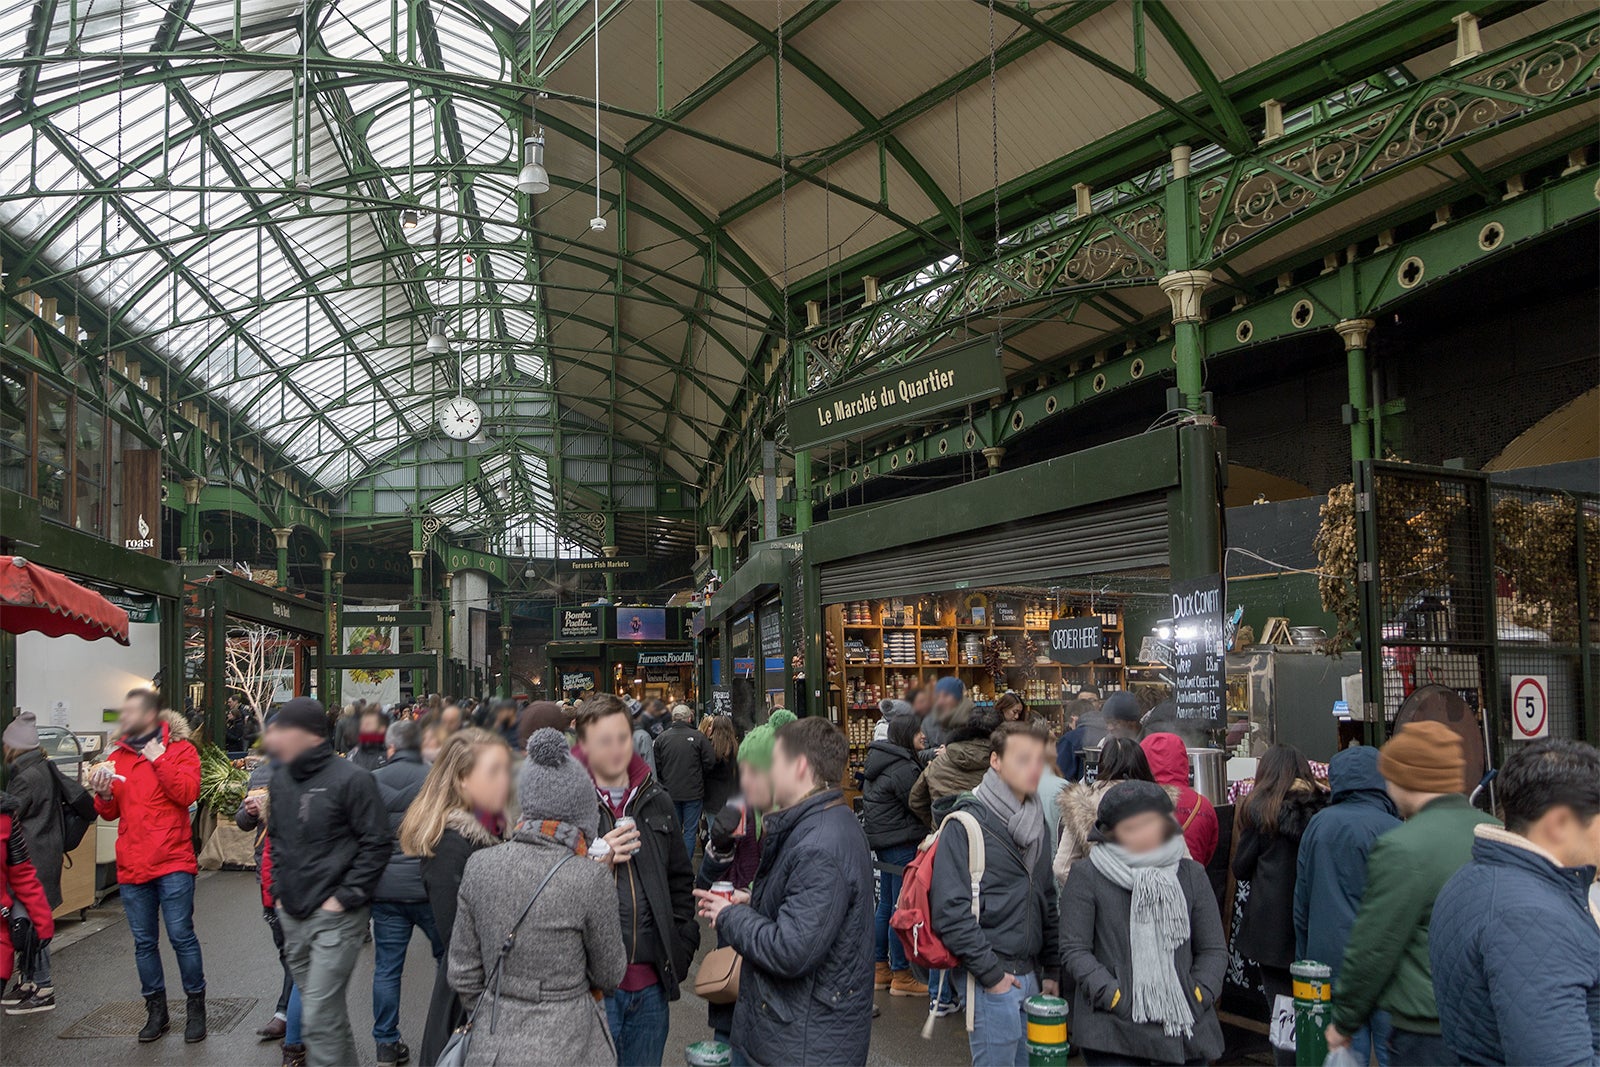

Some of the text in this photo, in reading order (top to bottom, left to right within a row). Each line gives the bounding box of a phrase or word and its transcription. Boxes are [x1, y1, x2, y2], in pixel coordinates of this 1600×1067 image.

[818, 368, 954, 426] Le Marché du Quartier
[125, 538, 154, 548] roast
[565, 610, 592, 620] Bomba
[1052, 626, 1099, 650] ORDER HERE
[638, 653, 666, 663] Furness
[667, 652, 685, 663] Food
[1526, 696, 1535, 718] 5
